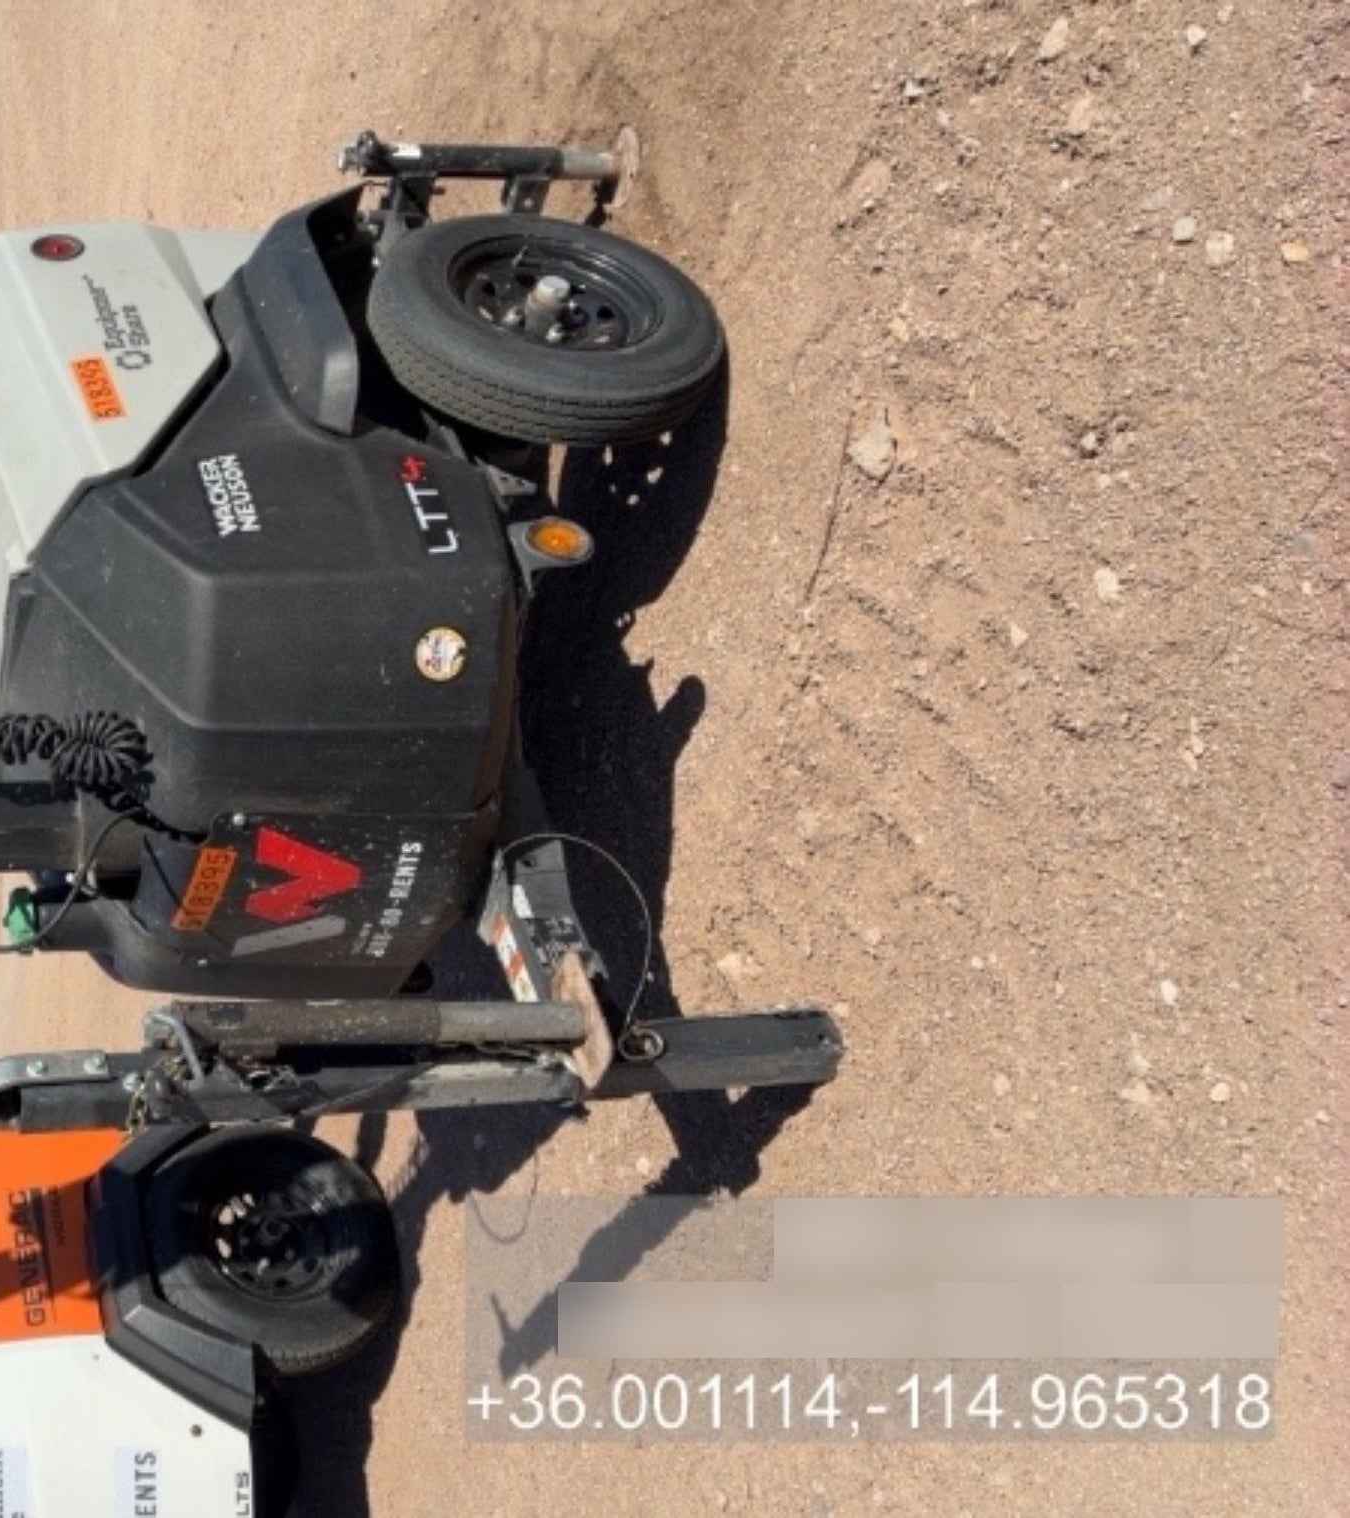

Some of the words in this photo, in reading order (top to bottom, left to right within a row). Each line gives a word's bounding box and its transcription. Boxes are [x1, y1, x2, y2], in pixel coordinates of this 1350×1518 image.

[77, 358, 123, 419] 518395
[197, 457, 238, 538] WACKER
[219, 453, 262, 533] NEUSON
[180, 852, 230, 930] 518395
[8, 1189, 47, 1326] GENERAC
